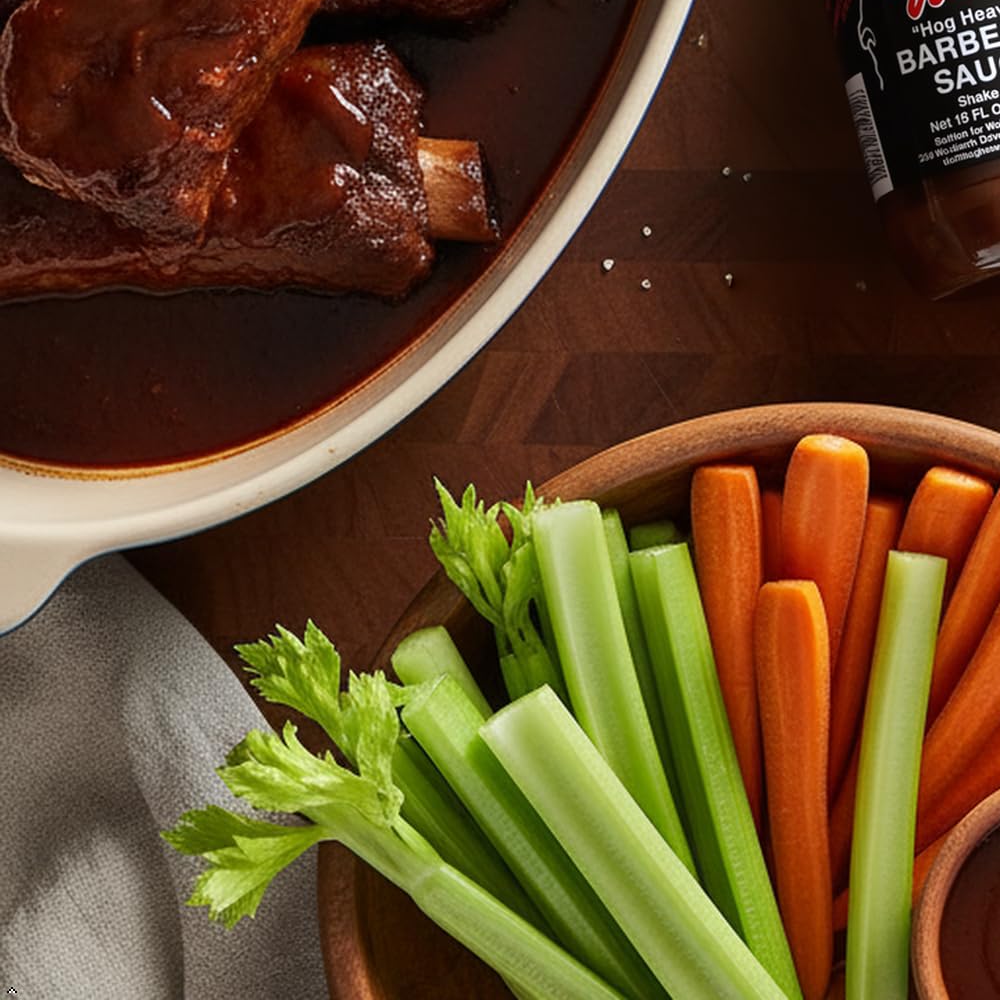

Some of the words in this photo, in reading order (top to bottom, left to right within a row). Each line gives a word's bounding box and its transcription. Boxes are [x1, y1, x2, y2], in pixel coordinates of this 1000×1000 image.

[957, 89, 1000, 107] Shake
[930, 117, 953, 133] Net
[971, 106, 990, 121] FL
